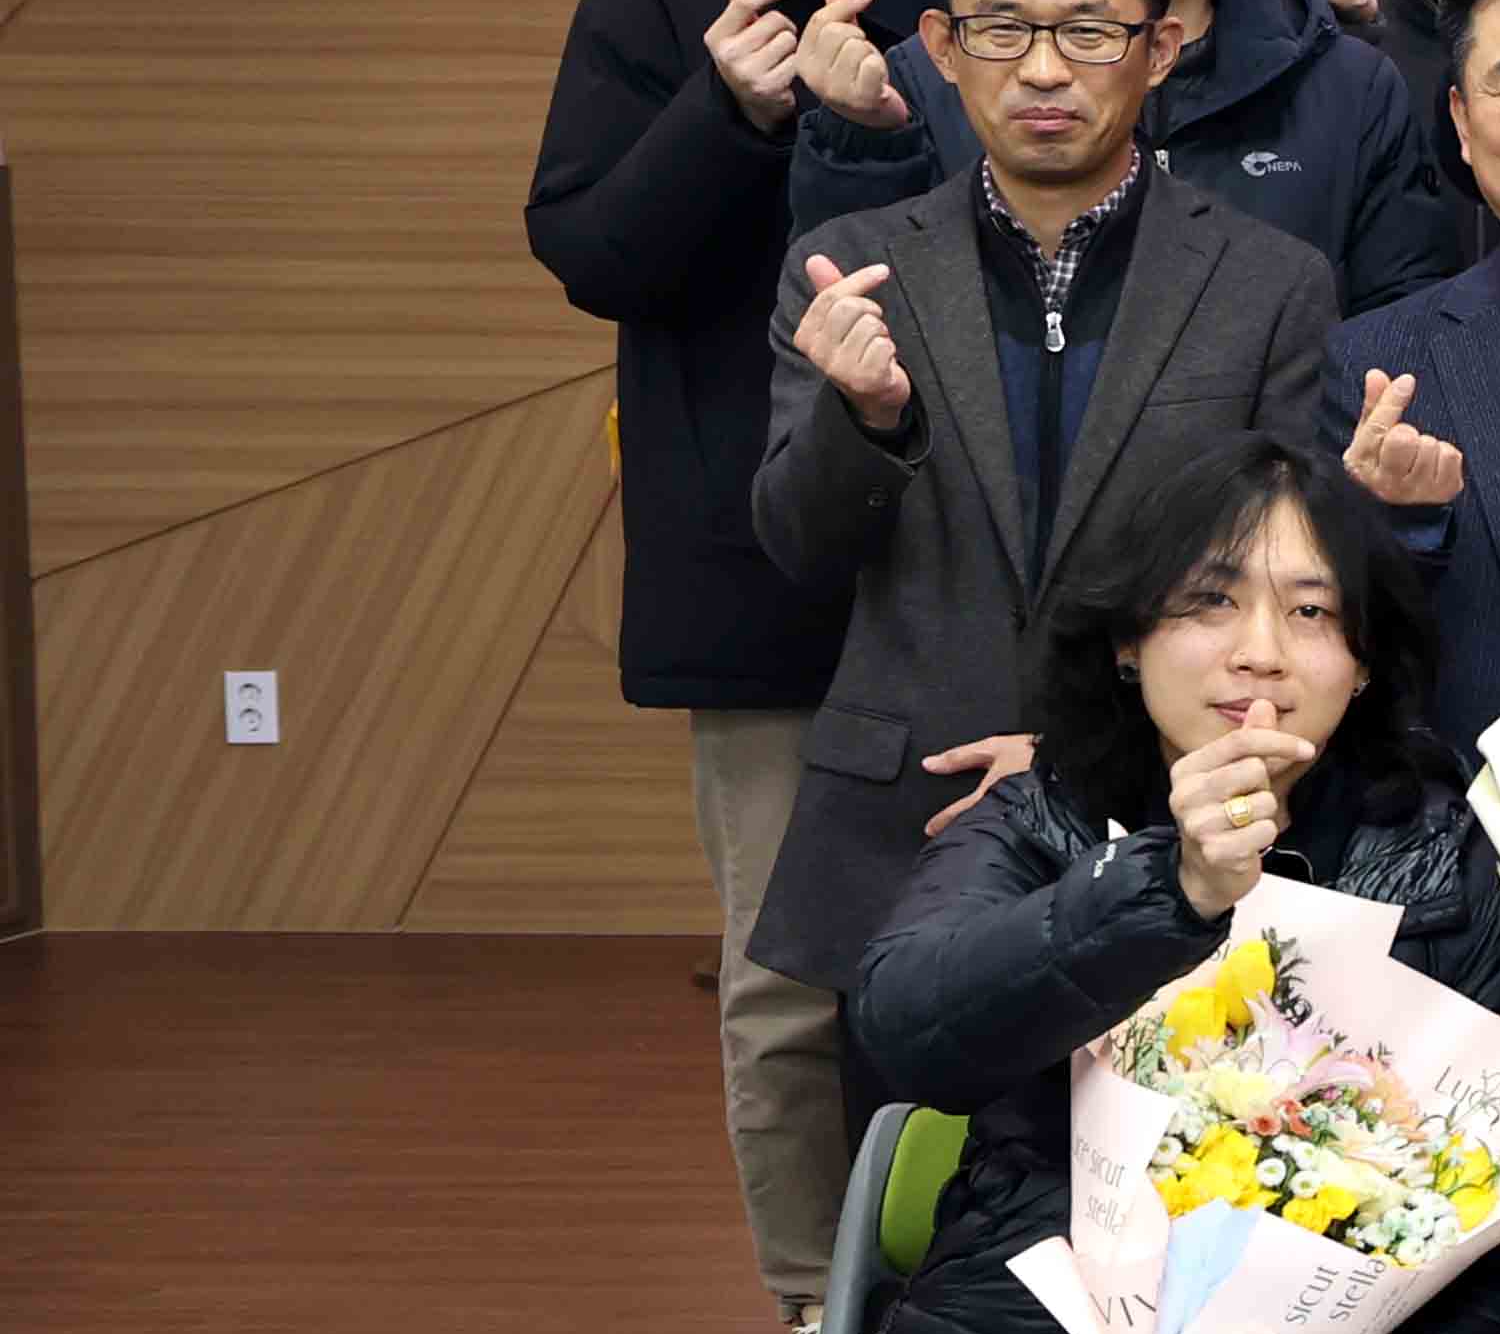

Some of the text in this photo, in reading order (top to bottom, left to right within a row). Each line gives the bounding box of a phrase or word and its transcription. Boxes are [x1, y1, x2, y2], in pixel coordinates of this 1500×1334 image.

[1089, 1147, 1127, 1188] sicut
[1086, 1194, 1129, 1236] stella
[1285, 1265, 1341, 1325] sicut
[1328, 1257, 1388, 1323] stella
